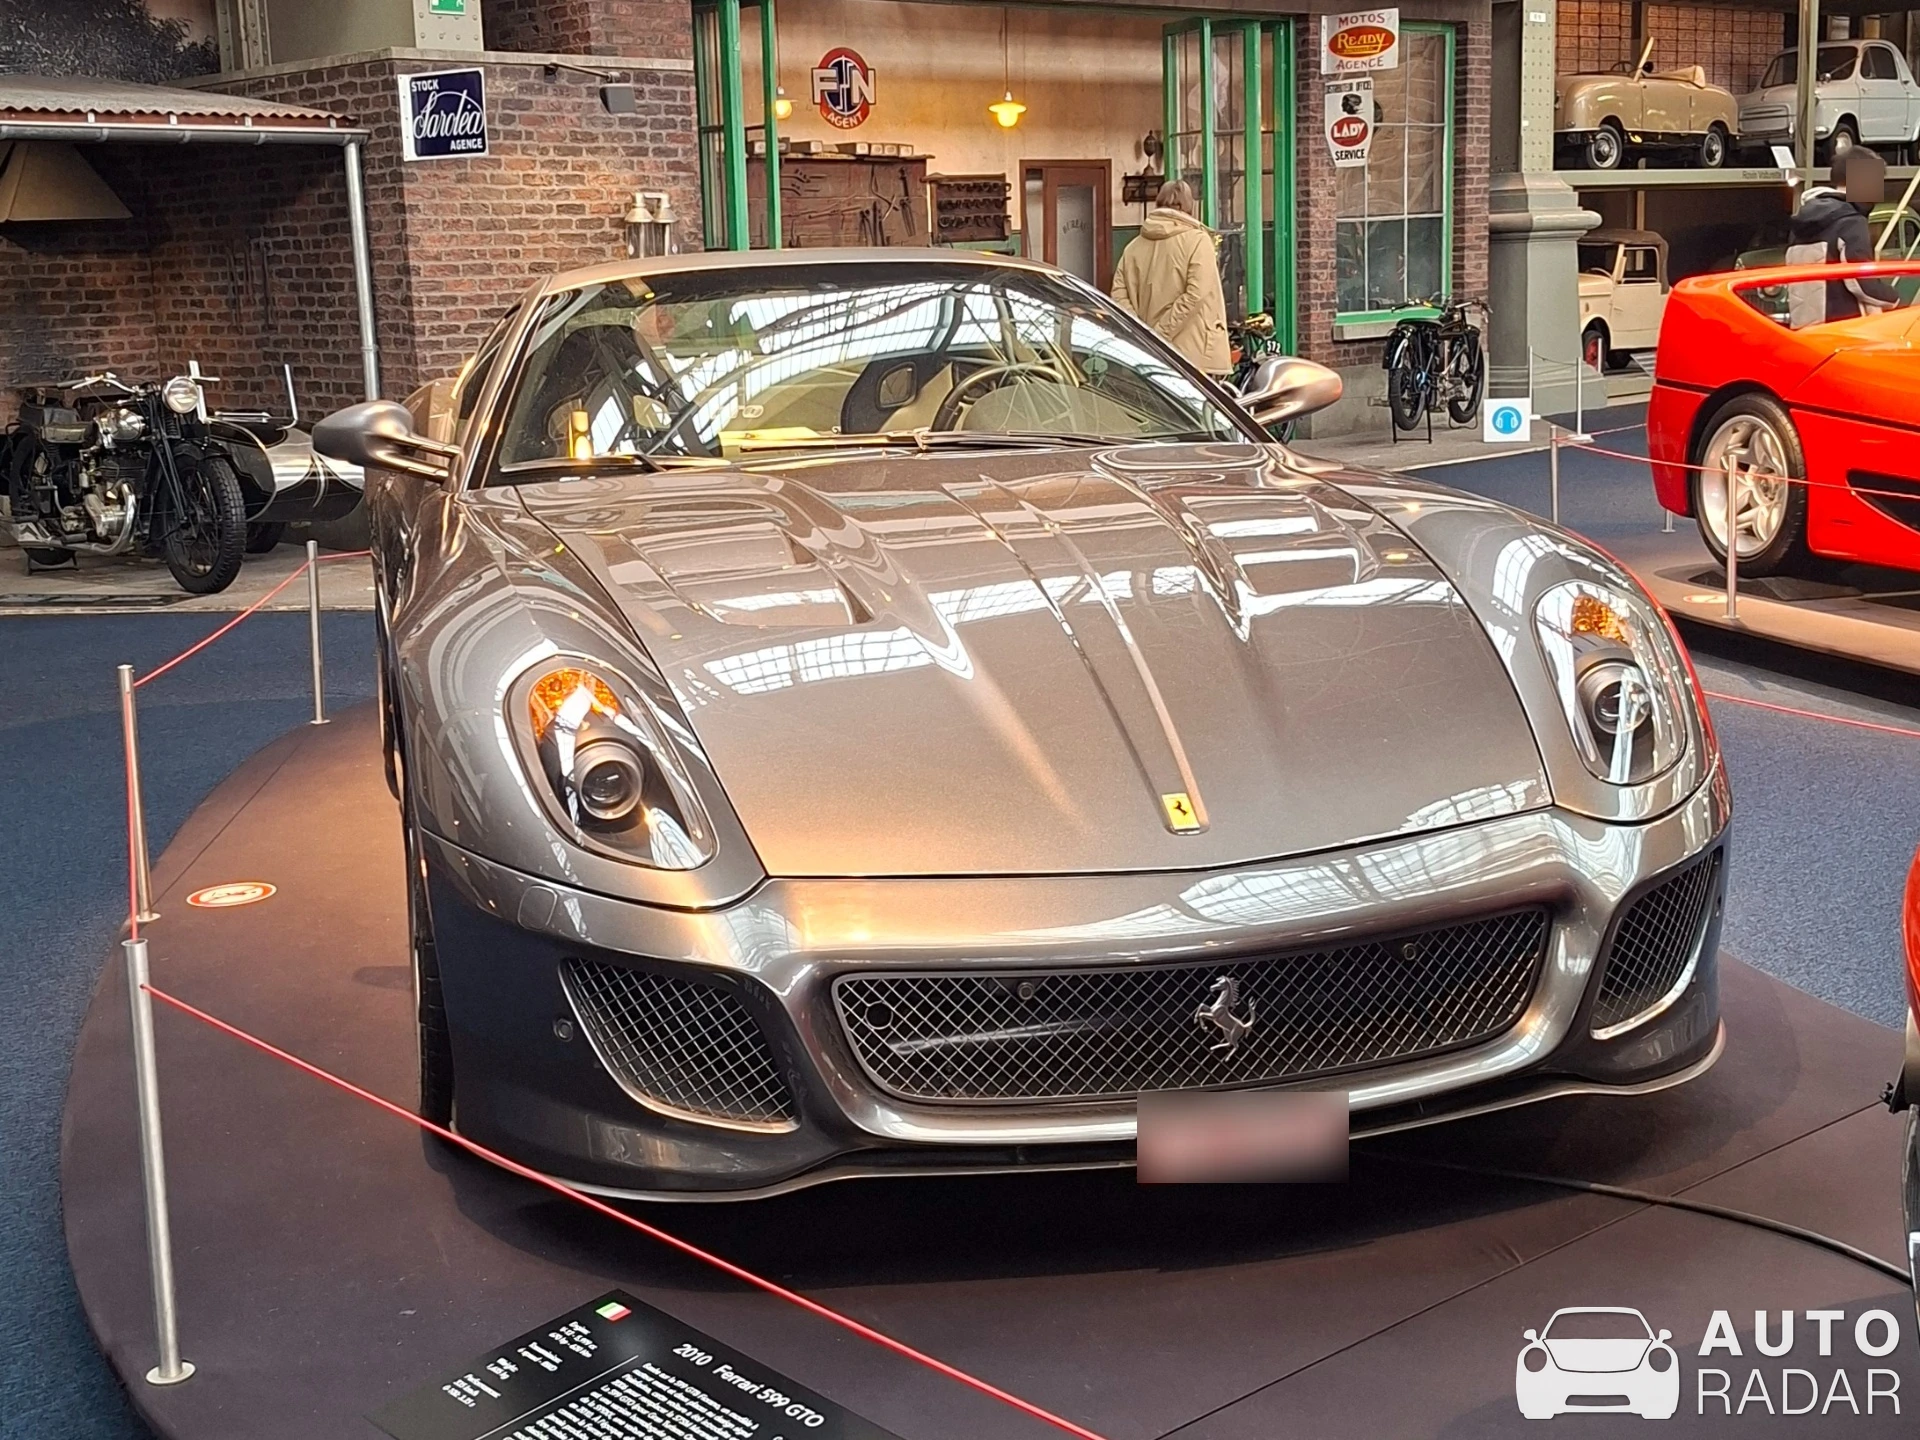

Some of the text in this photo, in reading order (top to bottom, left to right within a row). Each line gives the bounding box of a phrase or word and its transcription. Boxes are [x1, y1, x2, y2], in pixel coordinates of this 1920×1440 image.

[1338, 13, 1385, 28] MOTOS
[1336, 56, 1384, 71] AGENCE
[411, 79, 439, 92] STOCK
[827, 111, 863, 128] AGENT
[1333, 122, 1365, 138] LADY
[449, 138, 483, 151] AGENCE
[1335, 148, 1366, 160] SERVICE
[672, 1343, 825, 1428] 2010 Ferrari 599 GTO
